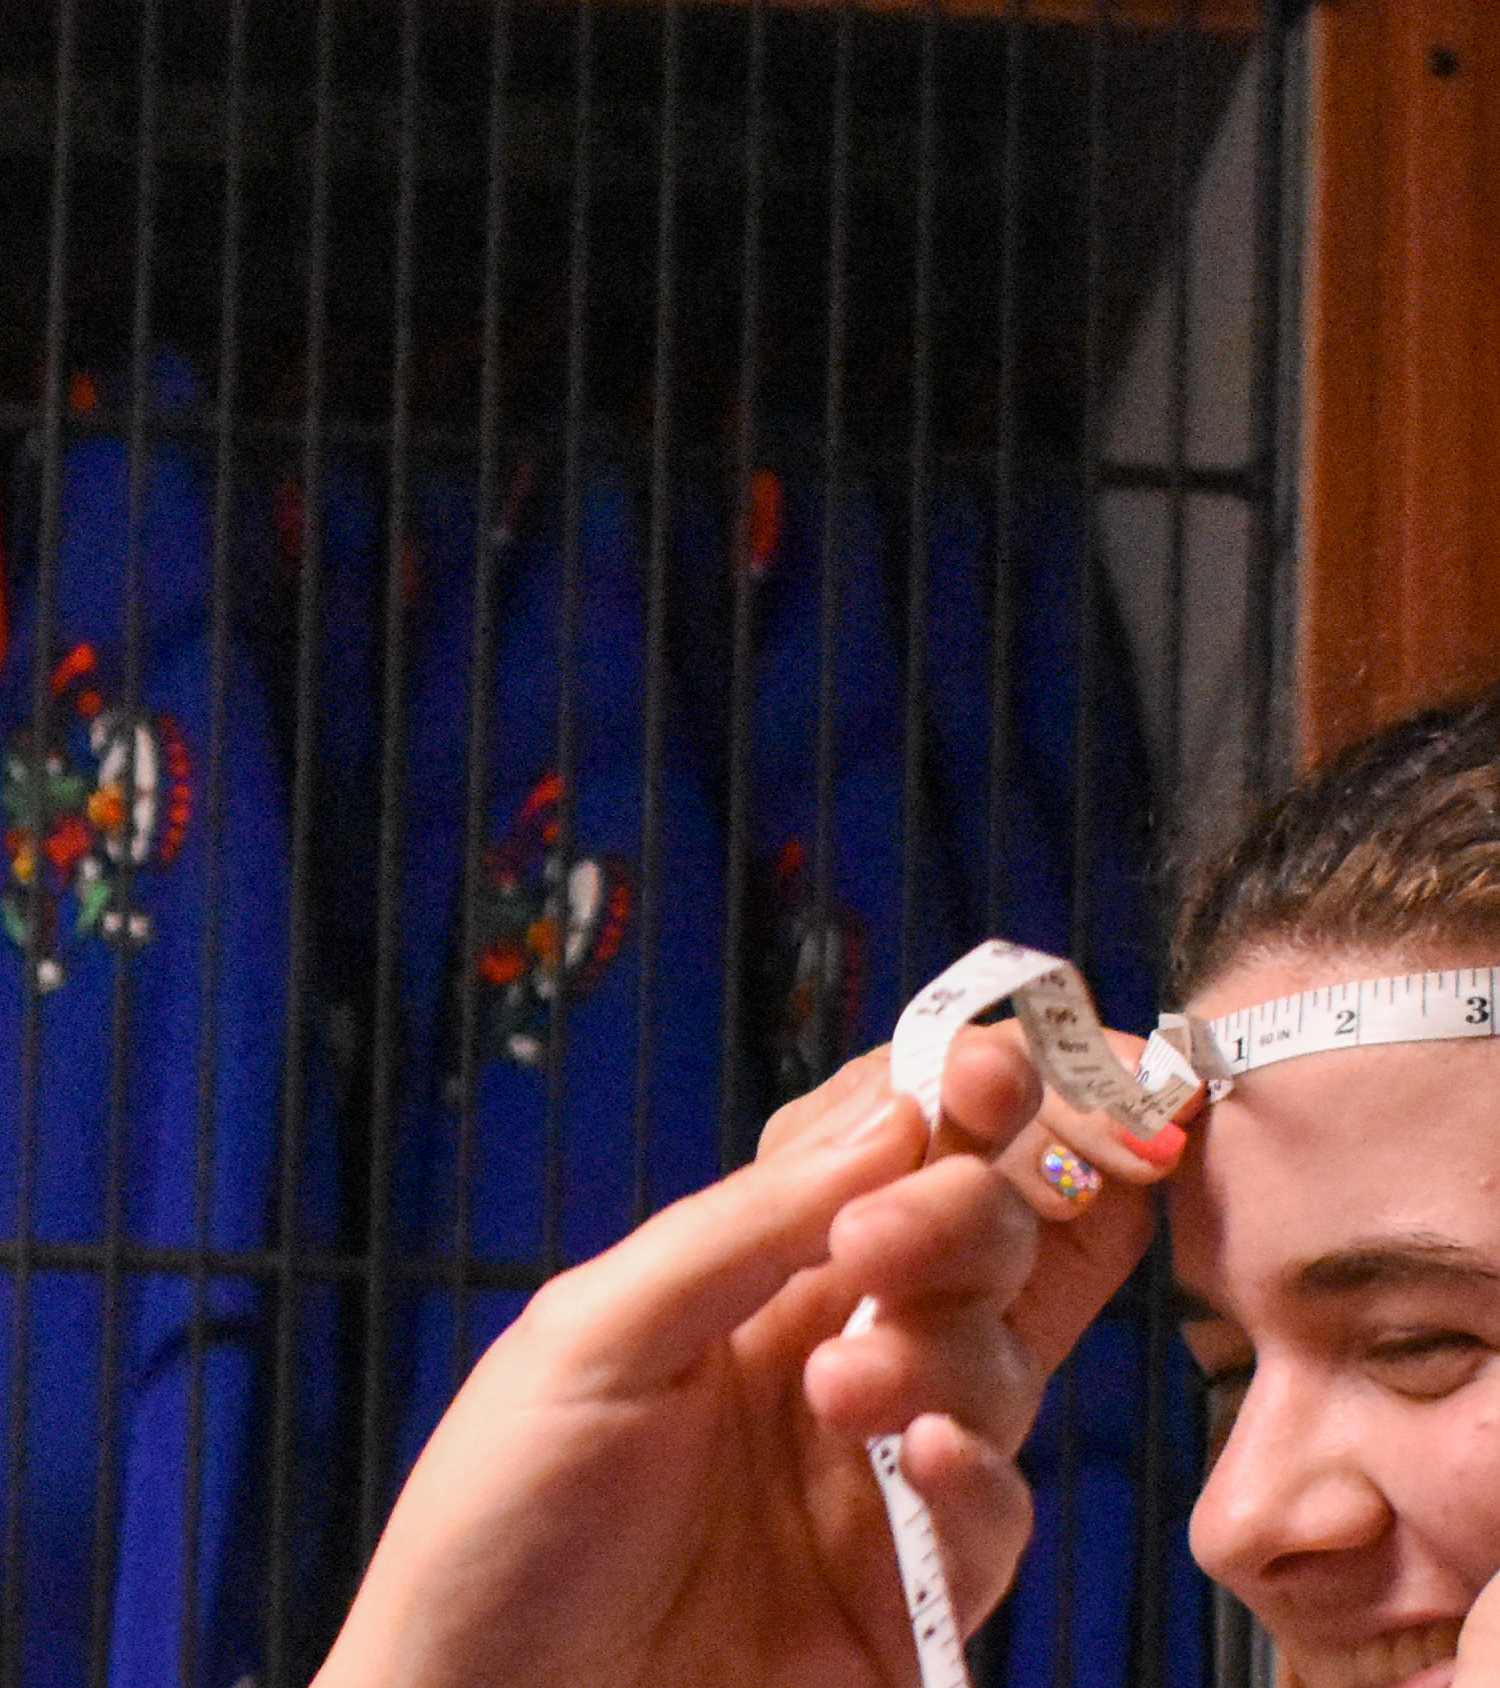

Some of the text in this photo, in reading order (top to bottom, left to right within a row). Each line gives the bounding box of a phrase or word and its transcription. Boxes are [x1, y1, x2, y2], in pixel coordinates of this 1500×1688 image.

[1233, 1036, 1246, 1062] 1
[1334, 1009, 1356, 1035] 2
[1465, 996, 1490, 1025] 3
